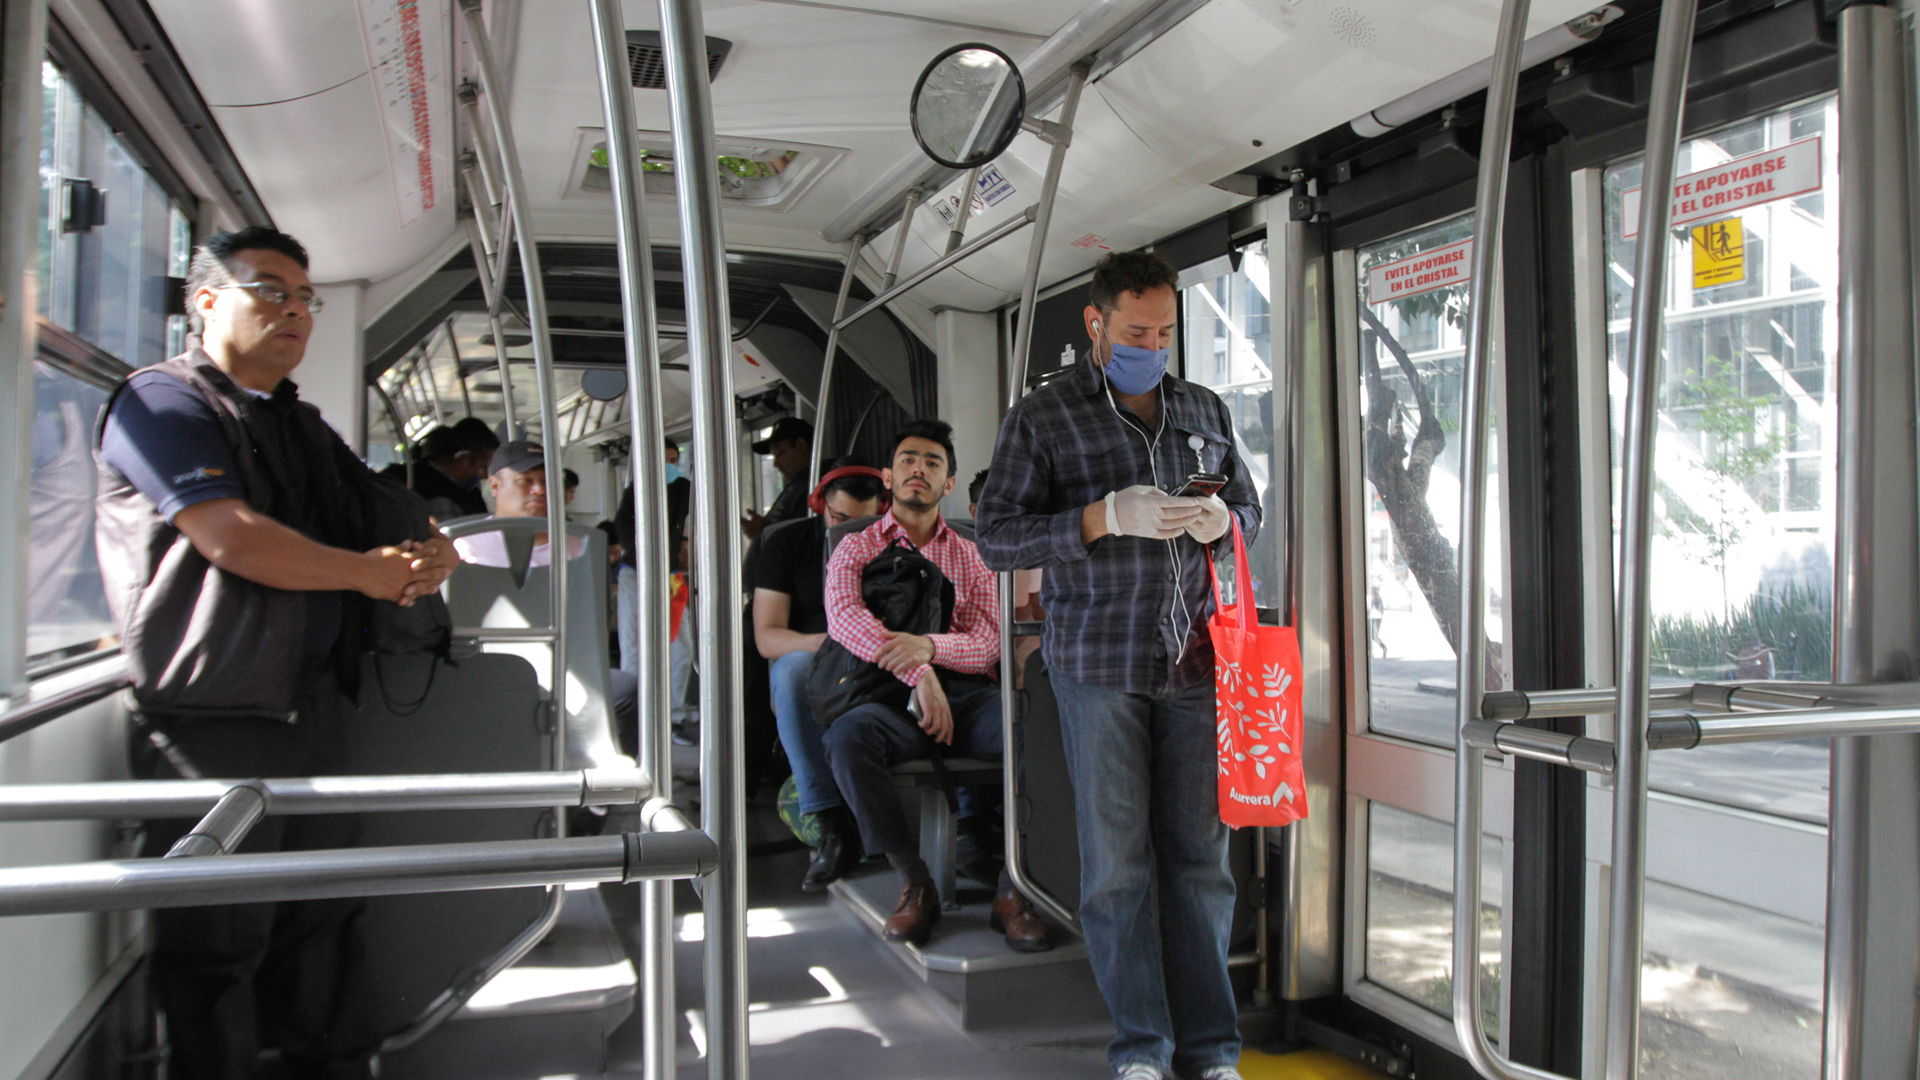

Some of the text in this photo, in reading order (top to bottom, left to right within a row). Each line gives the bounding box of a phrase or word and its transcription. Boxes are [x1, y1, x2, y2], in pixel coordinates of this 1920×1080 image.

[1695, 156, 1786, 193] APOYARSE
[1682, 199, 1698, 214] EL
[1702, 178, 1776, 208] CRISTAL
[1385, 249, 1465, 281] EVITE APOYARSE
[1391, 266, 1459, 293] EN EL CRISTAL
[1229, 786, 1271, 806] Aurrera
